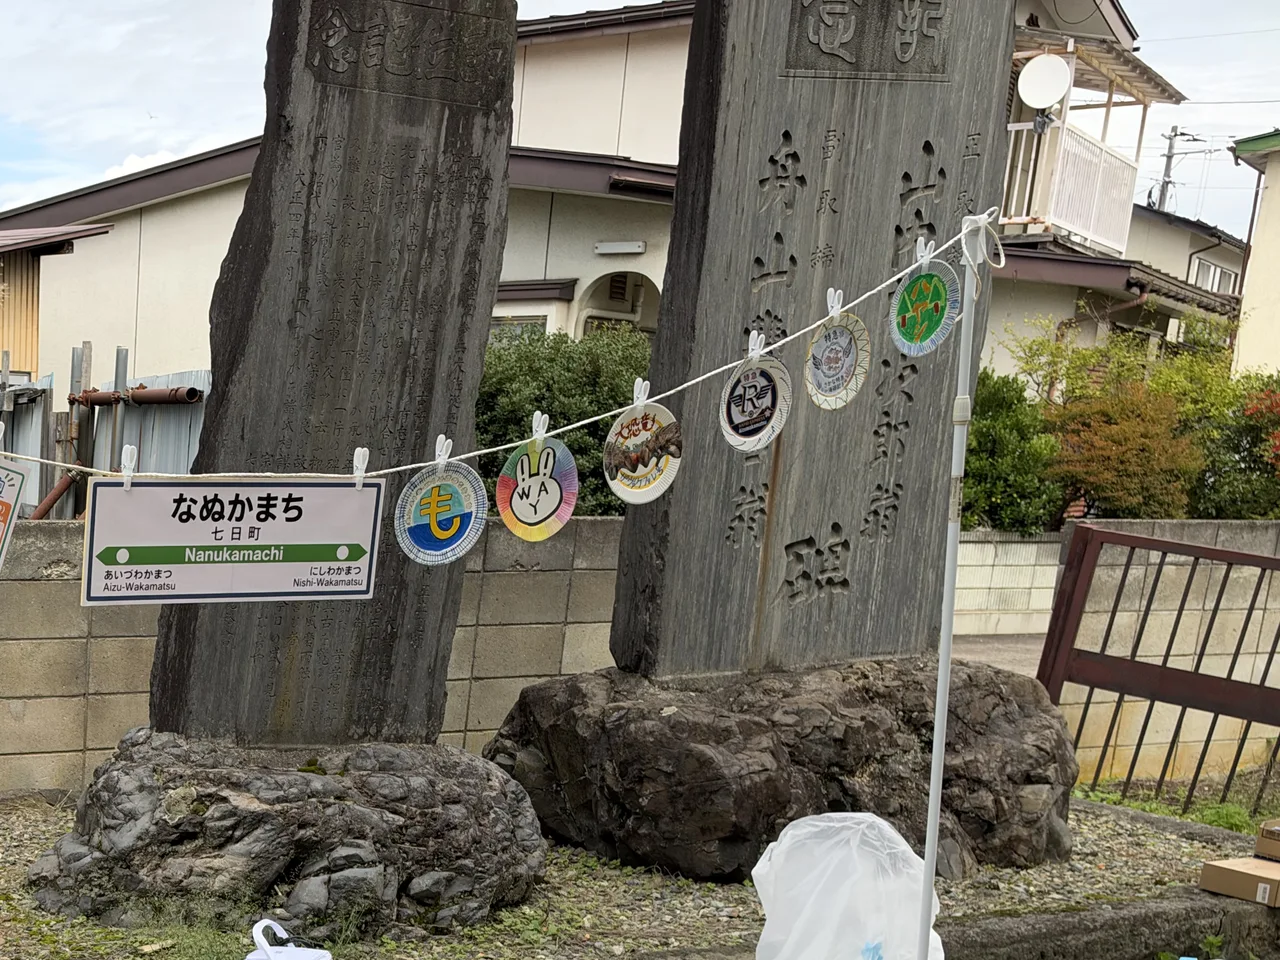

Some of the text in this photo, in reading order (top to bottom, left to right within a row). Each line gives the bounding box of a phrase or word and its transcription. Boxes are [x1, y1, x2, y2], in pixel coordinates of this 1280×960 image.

[171, 492, 304, 524] なぬかまち
[420, 485, 461, 541] も
[211, 526, 261, 541] 七日町
[185, 547, 284, 563] Nanukamachi
[104, 569, 173, 580] あいづわかまつ
[309, 566, 362, 576] にしわかまつ
[103, 581, 176, 592] Aizu-Wakamatsu
[293, 577, 363, 588] Nishi-Wakamatsu
